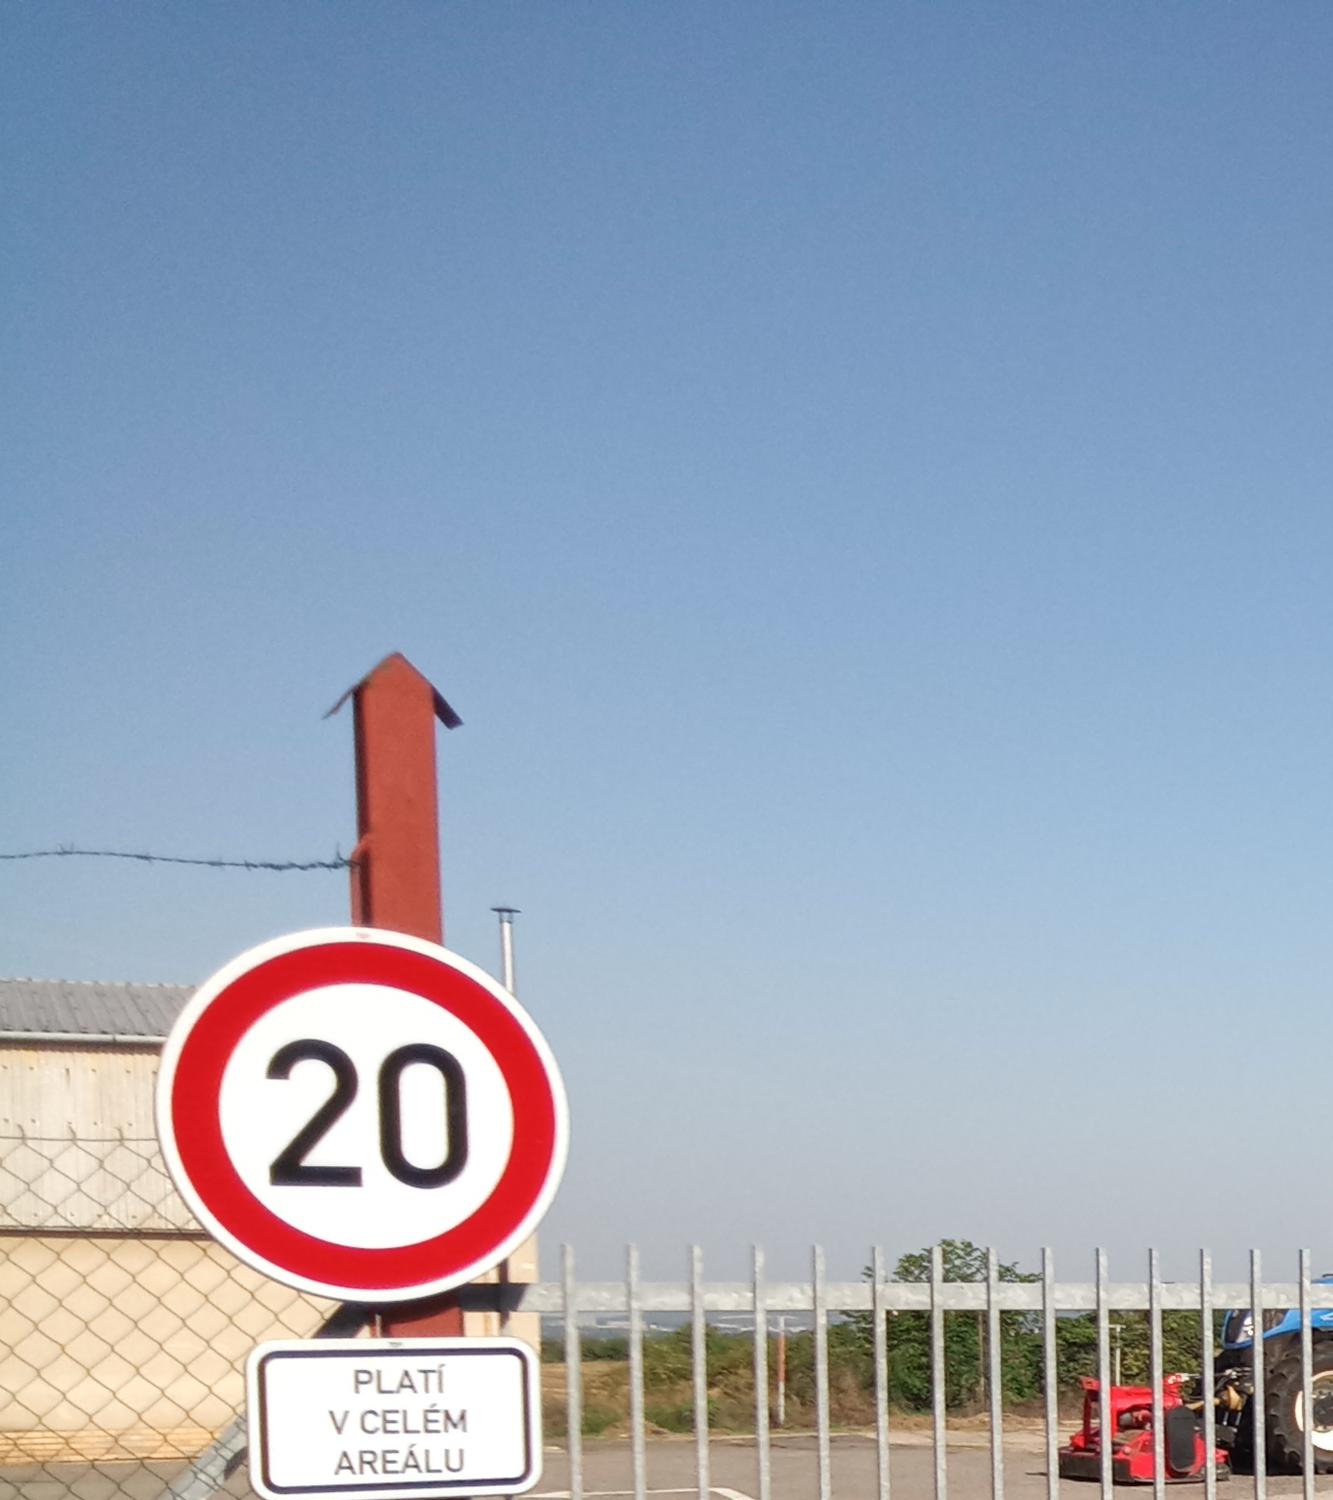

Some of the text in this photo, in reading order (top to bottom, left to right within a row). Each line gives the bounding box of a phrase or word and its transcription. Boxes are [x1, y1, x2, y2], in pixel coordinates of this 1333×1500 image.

[266, 1038, 469, 1190] 20
[353, 1364, 446, 1395] PLATÍ
[329, 1403, 468, 1435] V CELÉM
[334, 1444, 465, 1476] AREÁLU
